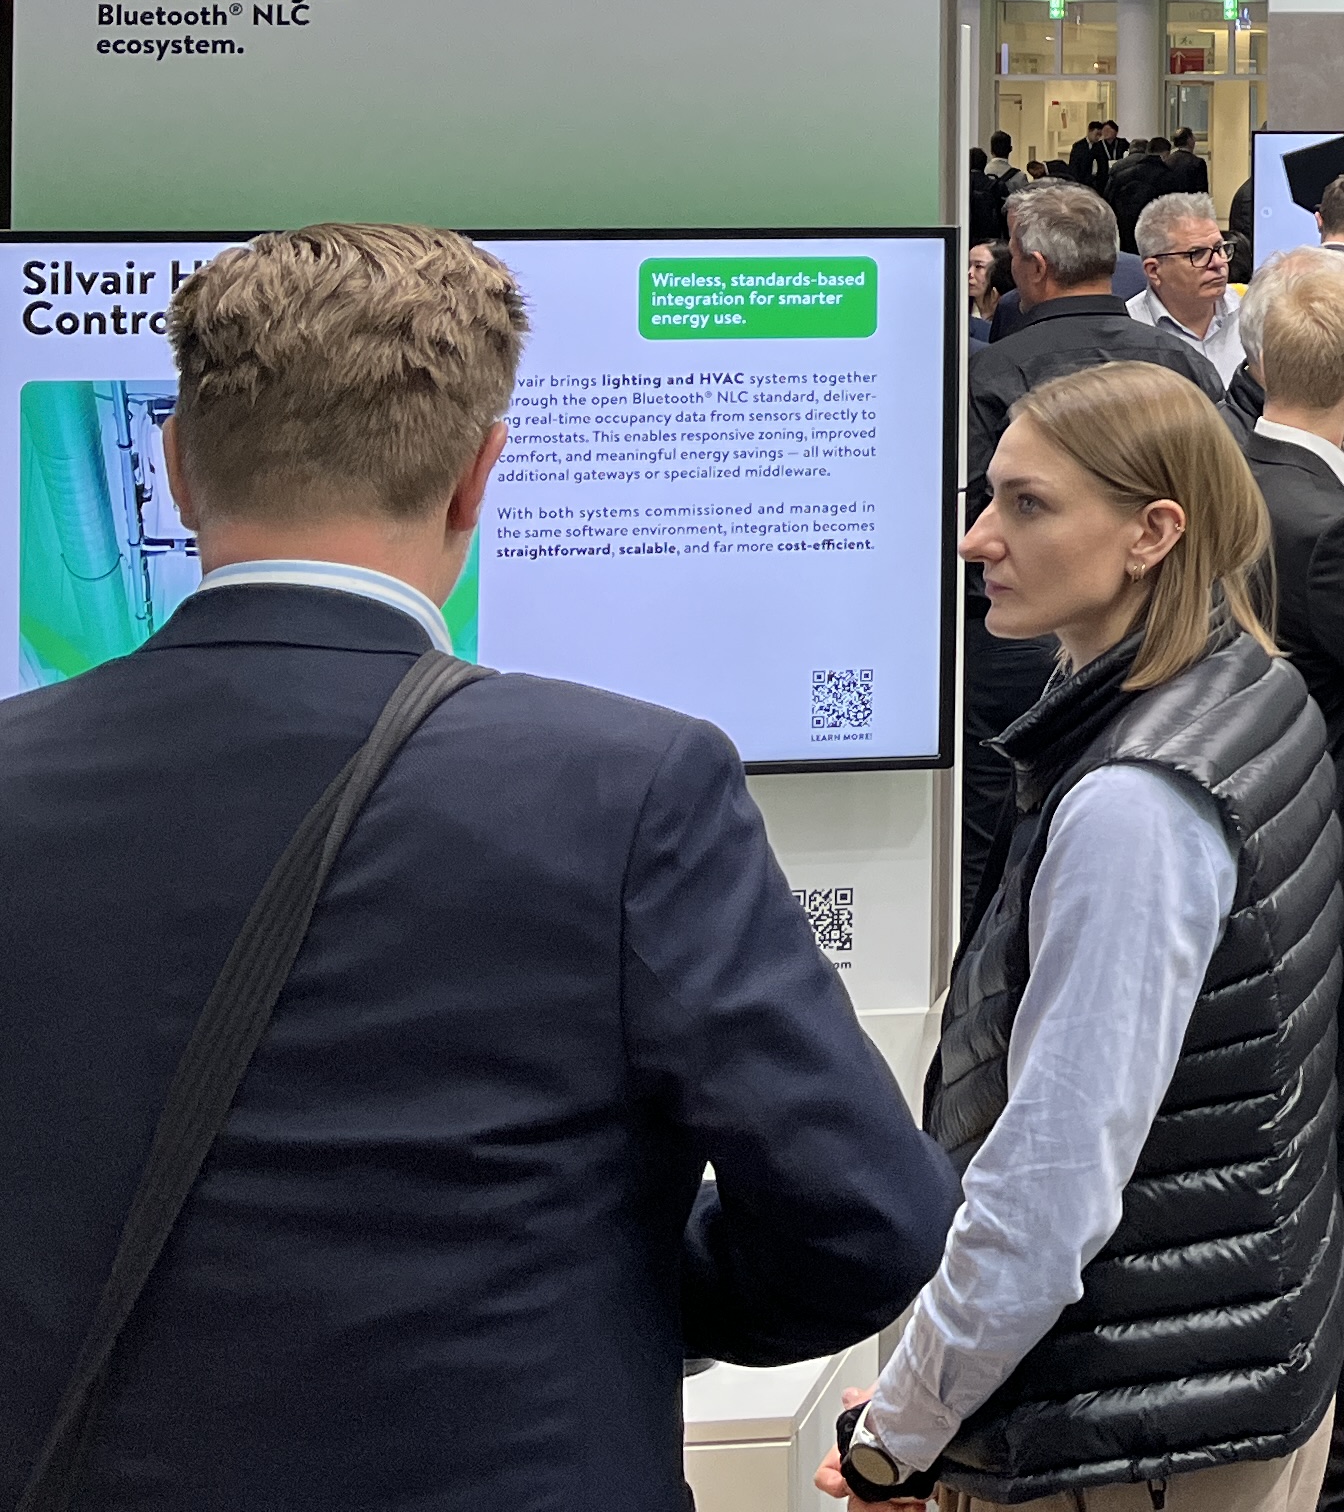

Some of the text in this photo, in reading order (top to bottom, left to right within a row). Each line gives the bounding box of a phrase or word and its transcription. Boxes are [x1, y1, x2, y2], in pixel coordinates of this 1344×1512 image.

[254, 4, 309, 25] NLC
[97, 36, 243, 61] ecosystem.
[23, 261, 156, 295] Silvair
[652, 272, 864, 289] Wireless, standards-based
[652, 291, 843, 309] integration for smarter
[23, 301, 167, 336] Contro
[652, 314, 746, 328] energy use.
[551, 371, 877, 389] brings lighting and HVAC systems together
[563, 393, 586, 405] the
[592, 397, 627, 408] open
[718, 391, 748, 403] NLC
[753, 390, 819, 404] standard,
[824, 390, 876, 401] deliver-
[498, 446, 876, 464] comfort, and meaningful energy savings all without
[498, 465, 830, 483] additional gateways or specialized middleware.
[497, 501, 874, 521] With both systems commissioned and managed in
[498, 520, 874, 538] the same software environment, integration becomes
[497, 538, 874, 560] straightforward, scalable, and far more cost-efficient.
